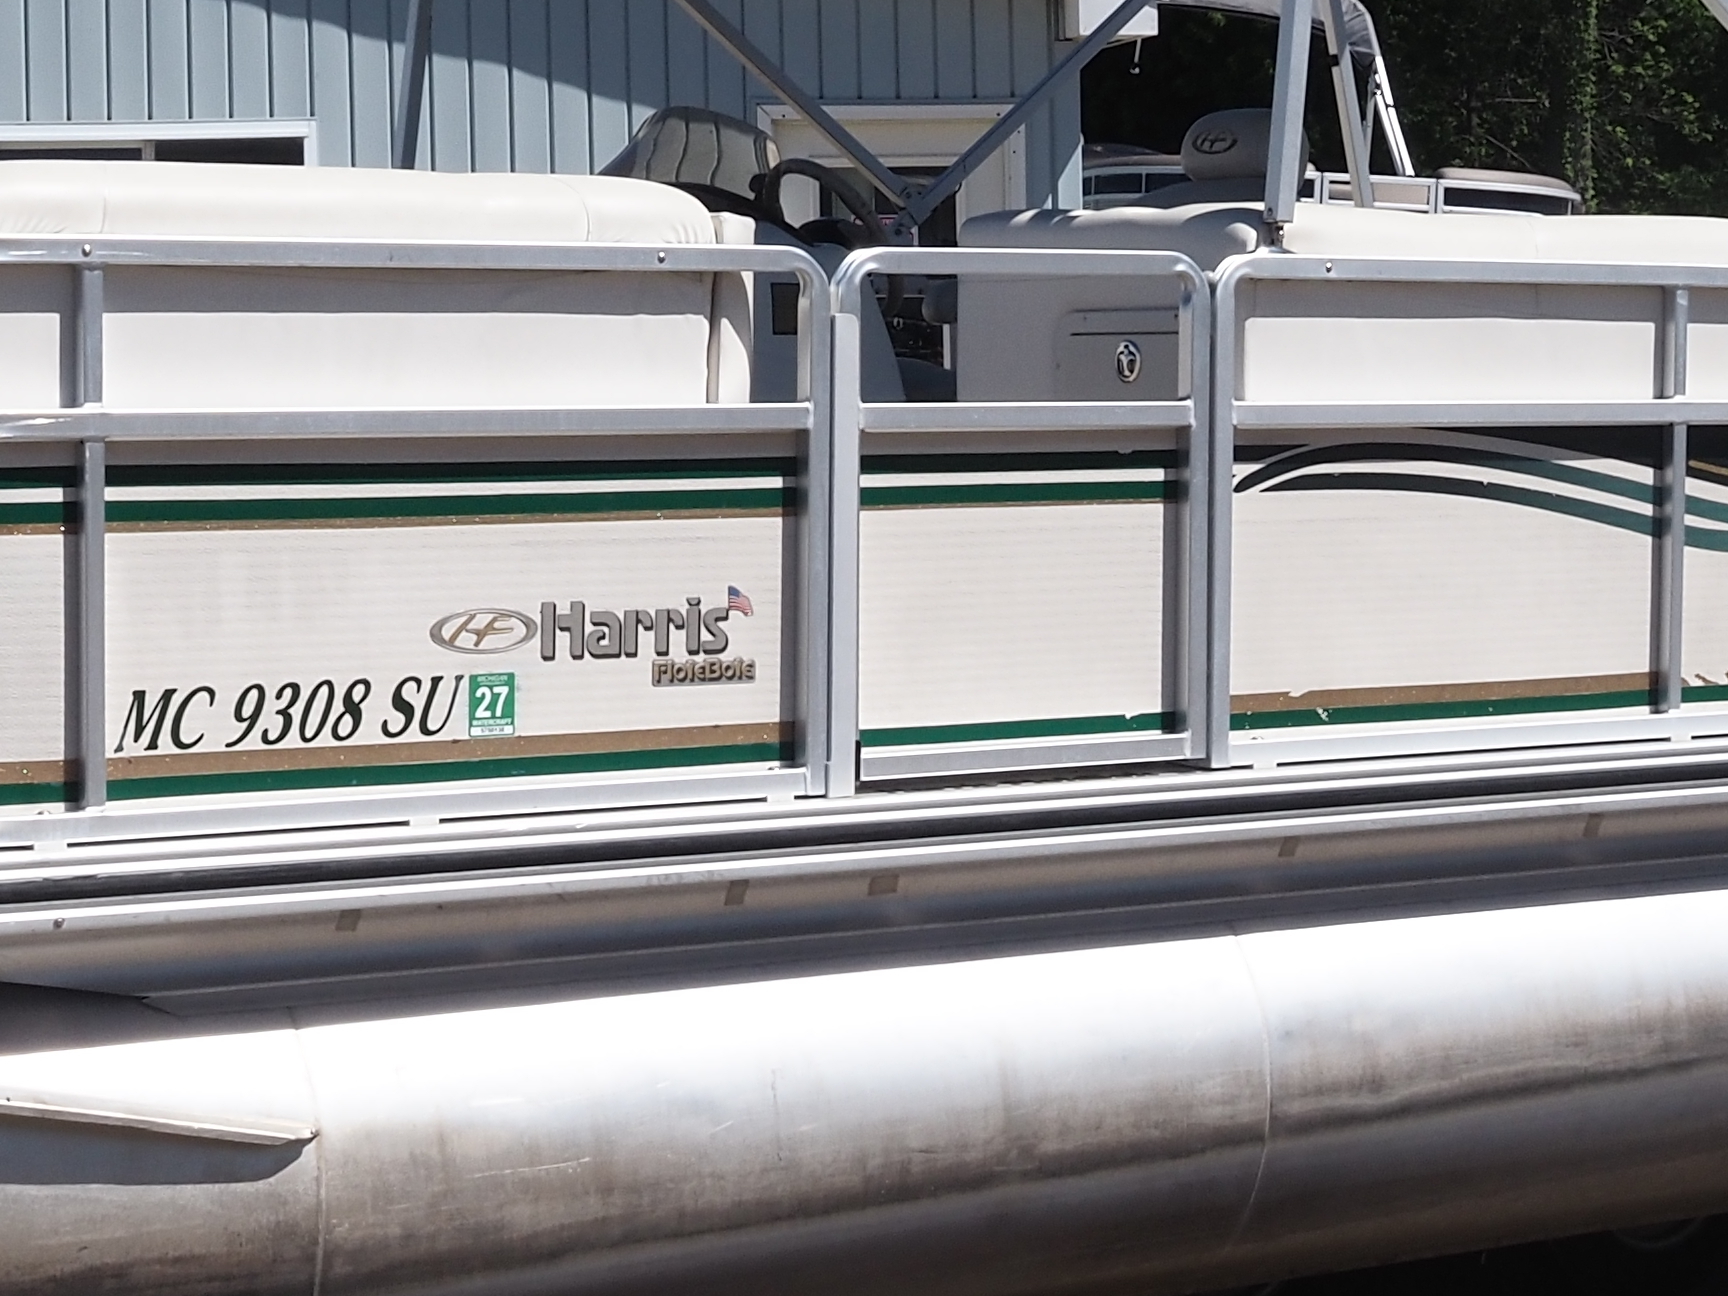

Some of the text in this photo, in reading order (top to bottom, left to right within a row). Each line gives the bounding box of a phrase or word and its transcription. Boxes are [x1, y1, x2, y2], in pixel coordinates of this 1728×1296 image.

[539, 596, 730, 662] Harris
[113, 674, 465, 754] MC 9308 SU
[474, 685, 510, 719] 27
